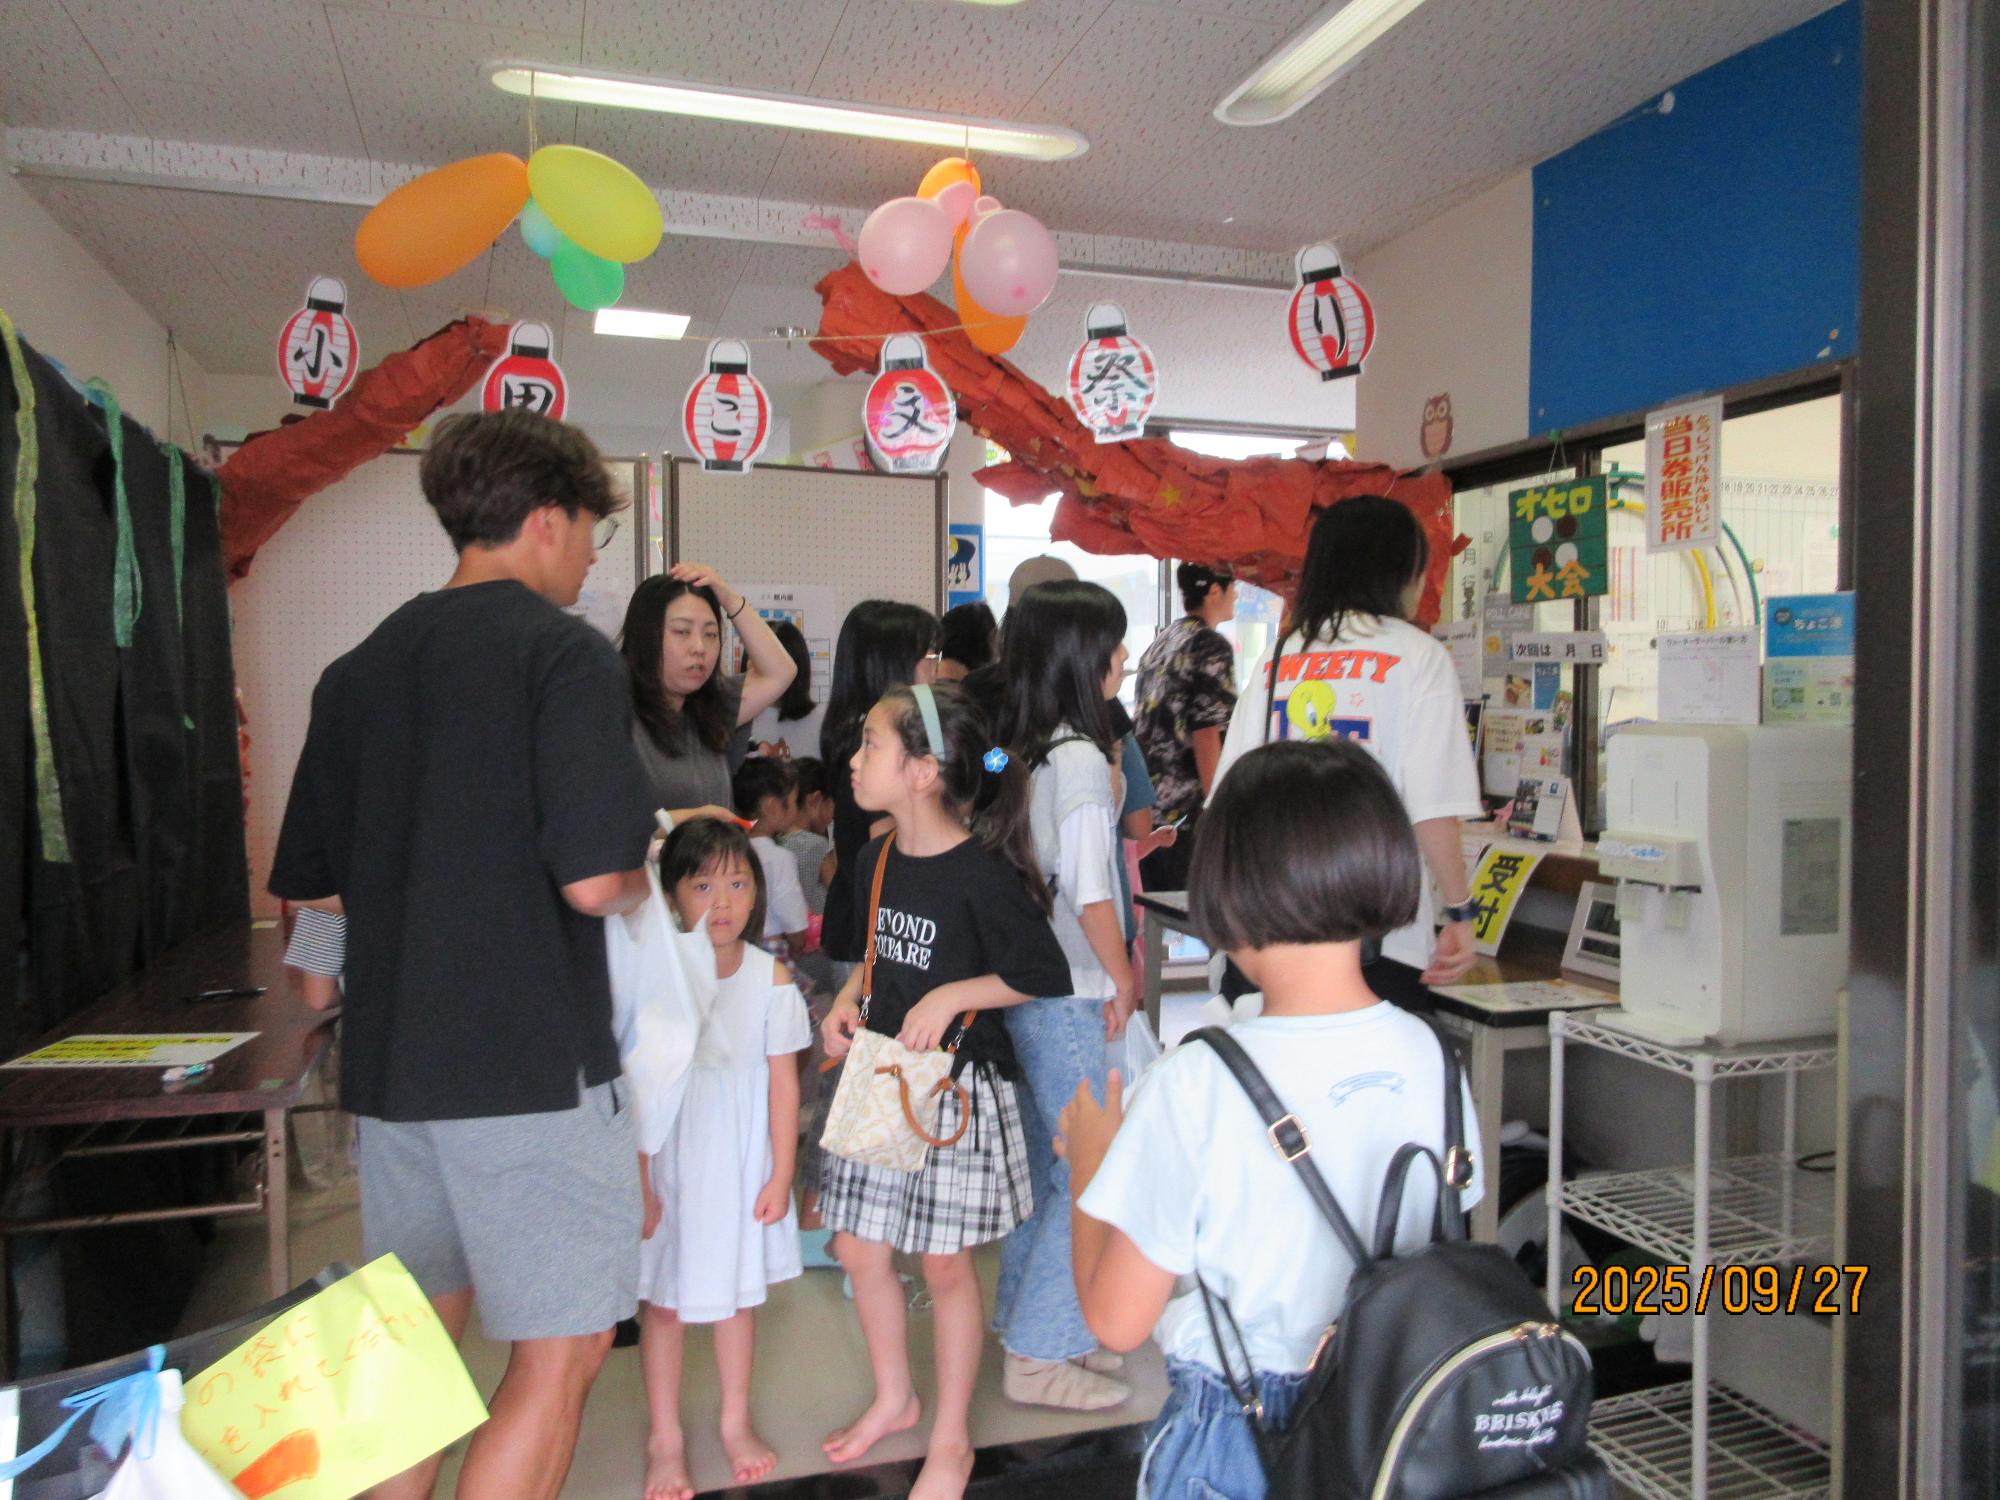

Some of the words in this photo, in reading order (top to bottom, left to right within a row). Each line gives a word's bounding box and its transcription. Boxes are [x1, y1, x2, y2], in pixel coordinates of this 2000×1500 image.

[294, 328, 343, 378] 小
[504, 382, 554, 413] 田
[711, 397, 743, 437] こ
[880, 386, 933, 438] 文
[1084, 351, 1152, 414] 祭
[1312, 293, 1348, 361] り
[1660, 415, 1694, 543] 当日券販売所
[1516, 485, 1592, 522] オセロ
[1526, 559, 1590, 601] 大会
[1263, 651, 1401, 689] TWEETY
[1516, 643, 1551, 657] 次回は
[1565, 643, 1576, 658] 月
[1592, 643, 1603, 657] 日
